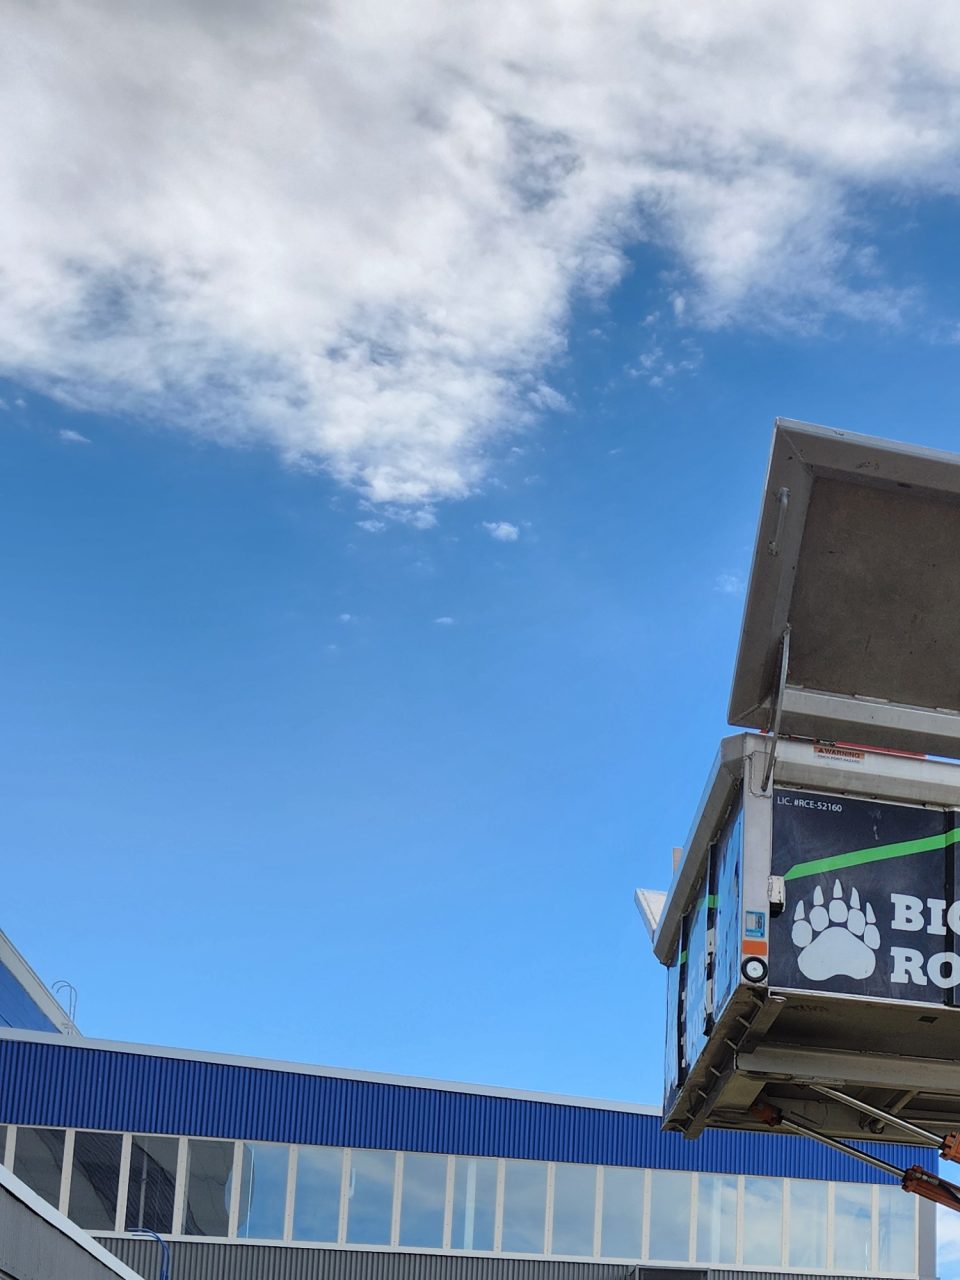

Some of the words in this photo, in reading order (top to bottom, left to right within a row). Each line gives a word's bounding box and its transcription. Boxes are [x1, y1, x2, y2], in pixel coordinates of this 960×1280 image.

[824, 748, 860, 758] WARNING
[777, 796, 793, 806] LIC.
[794, 799, 842, 812] #RCE-52160
